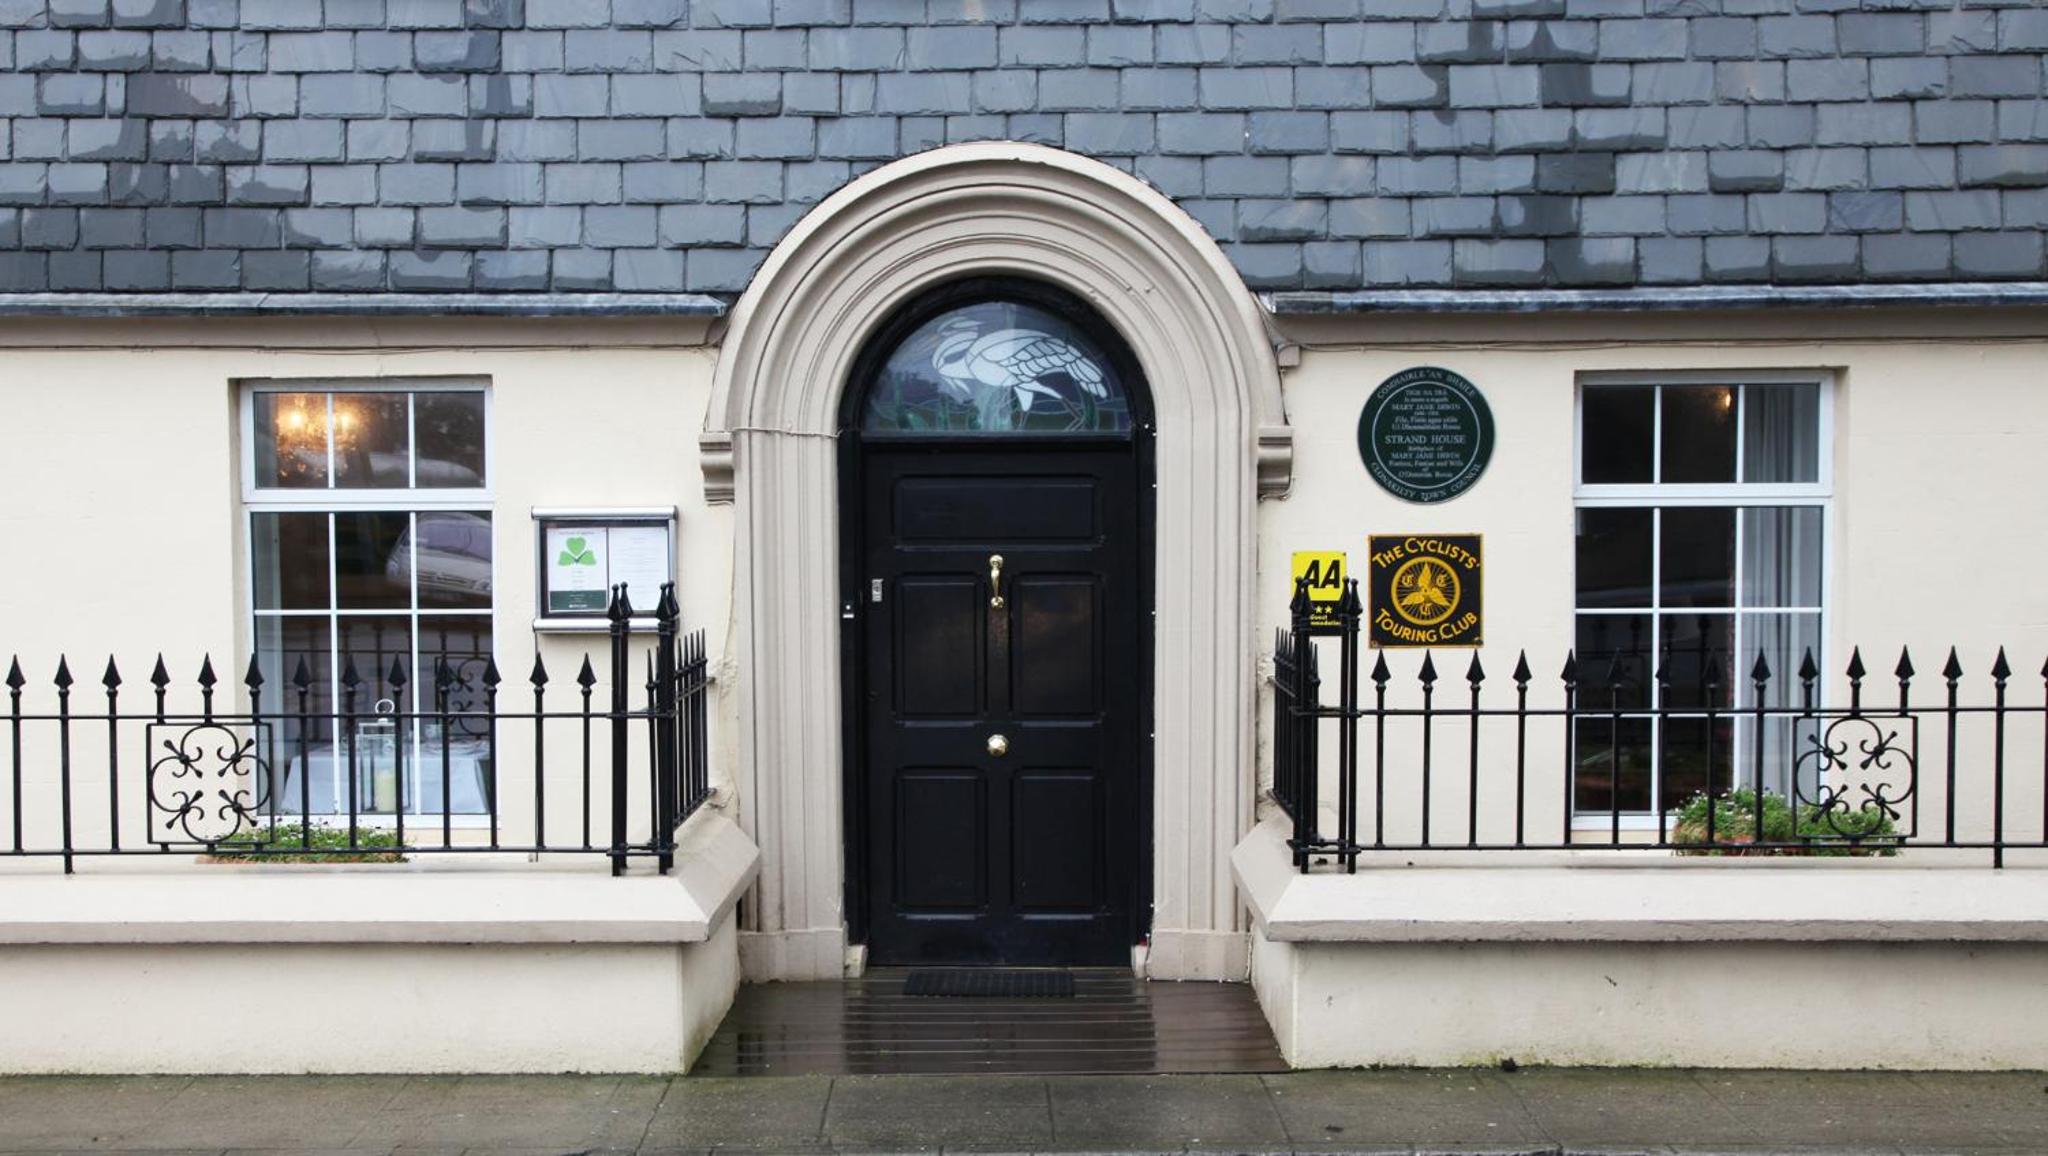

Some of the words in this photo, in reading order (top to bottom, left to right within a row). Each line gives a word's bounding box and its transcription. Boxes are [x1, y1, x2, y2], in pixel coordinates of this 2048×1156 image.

[1385, 435, 1426, 444] STRAND
[1431, 435, 1466, 444] HOUSE
[1372, 545, 1405, 568] THE
[1405, 537, 1480, 569] CYCLISTS'
[1303, 559, 1341, 589] AA
[1375, 608, 1437, 642] TOURING
[1439, 612, 1477, 640] CLUB
